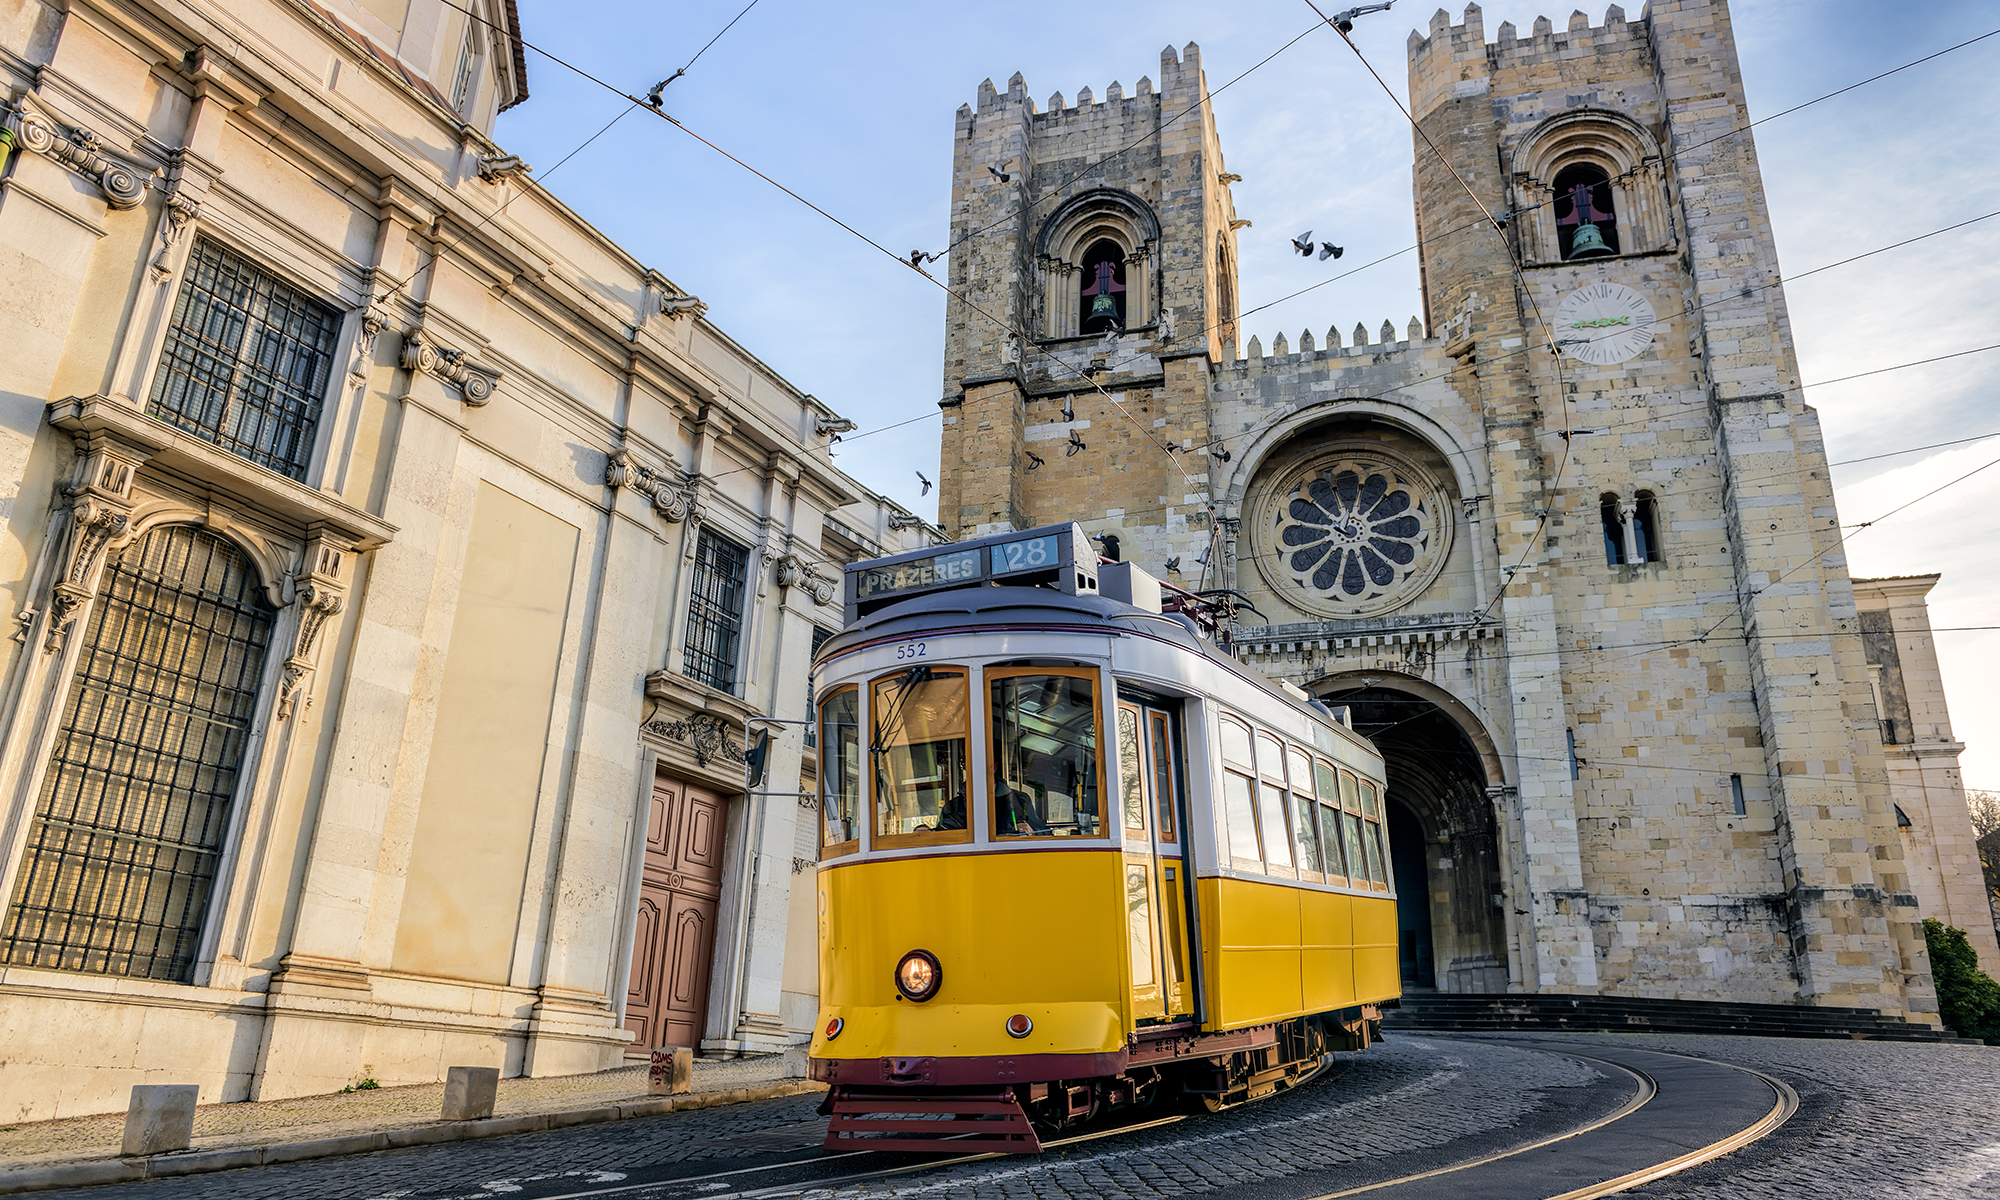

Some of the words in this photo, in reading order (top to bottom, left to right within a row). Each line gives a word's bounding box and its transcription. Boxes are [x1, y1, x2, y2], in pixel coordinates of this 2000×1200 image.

[1573, 290, 1590, 306] XI
[1593, 284, 1608, 299] XII
[1617, 287, 1625, 300] I
[1629, 298, 1645, 310] II
[1006, 538, 1047, 571] 28
[867, 558, 974, 593] PRAZERES
[897, 642, 926, 660] 552
